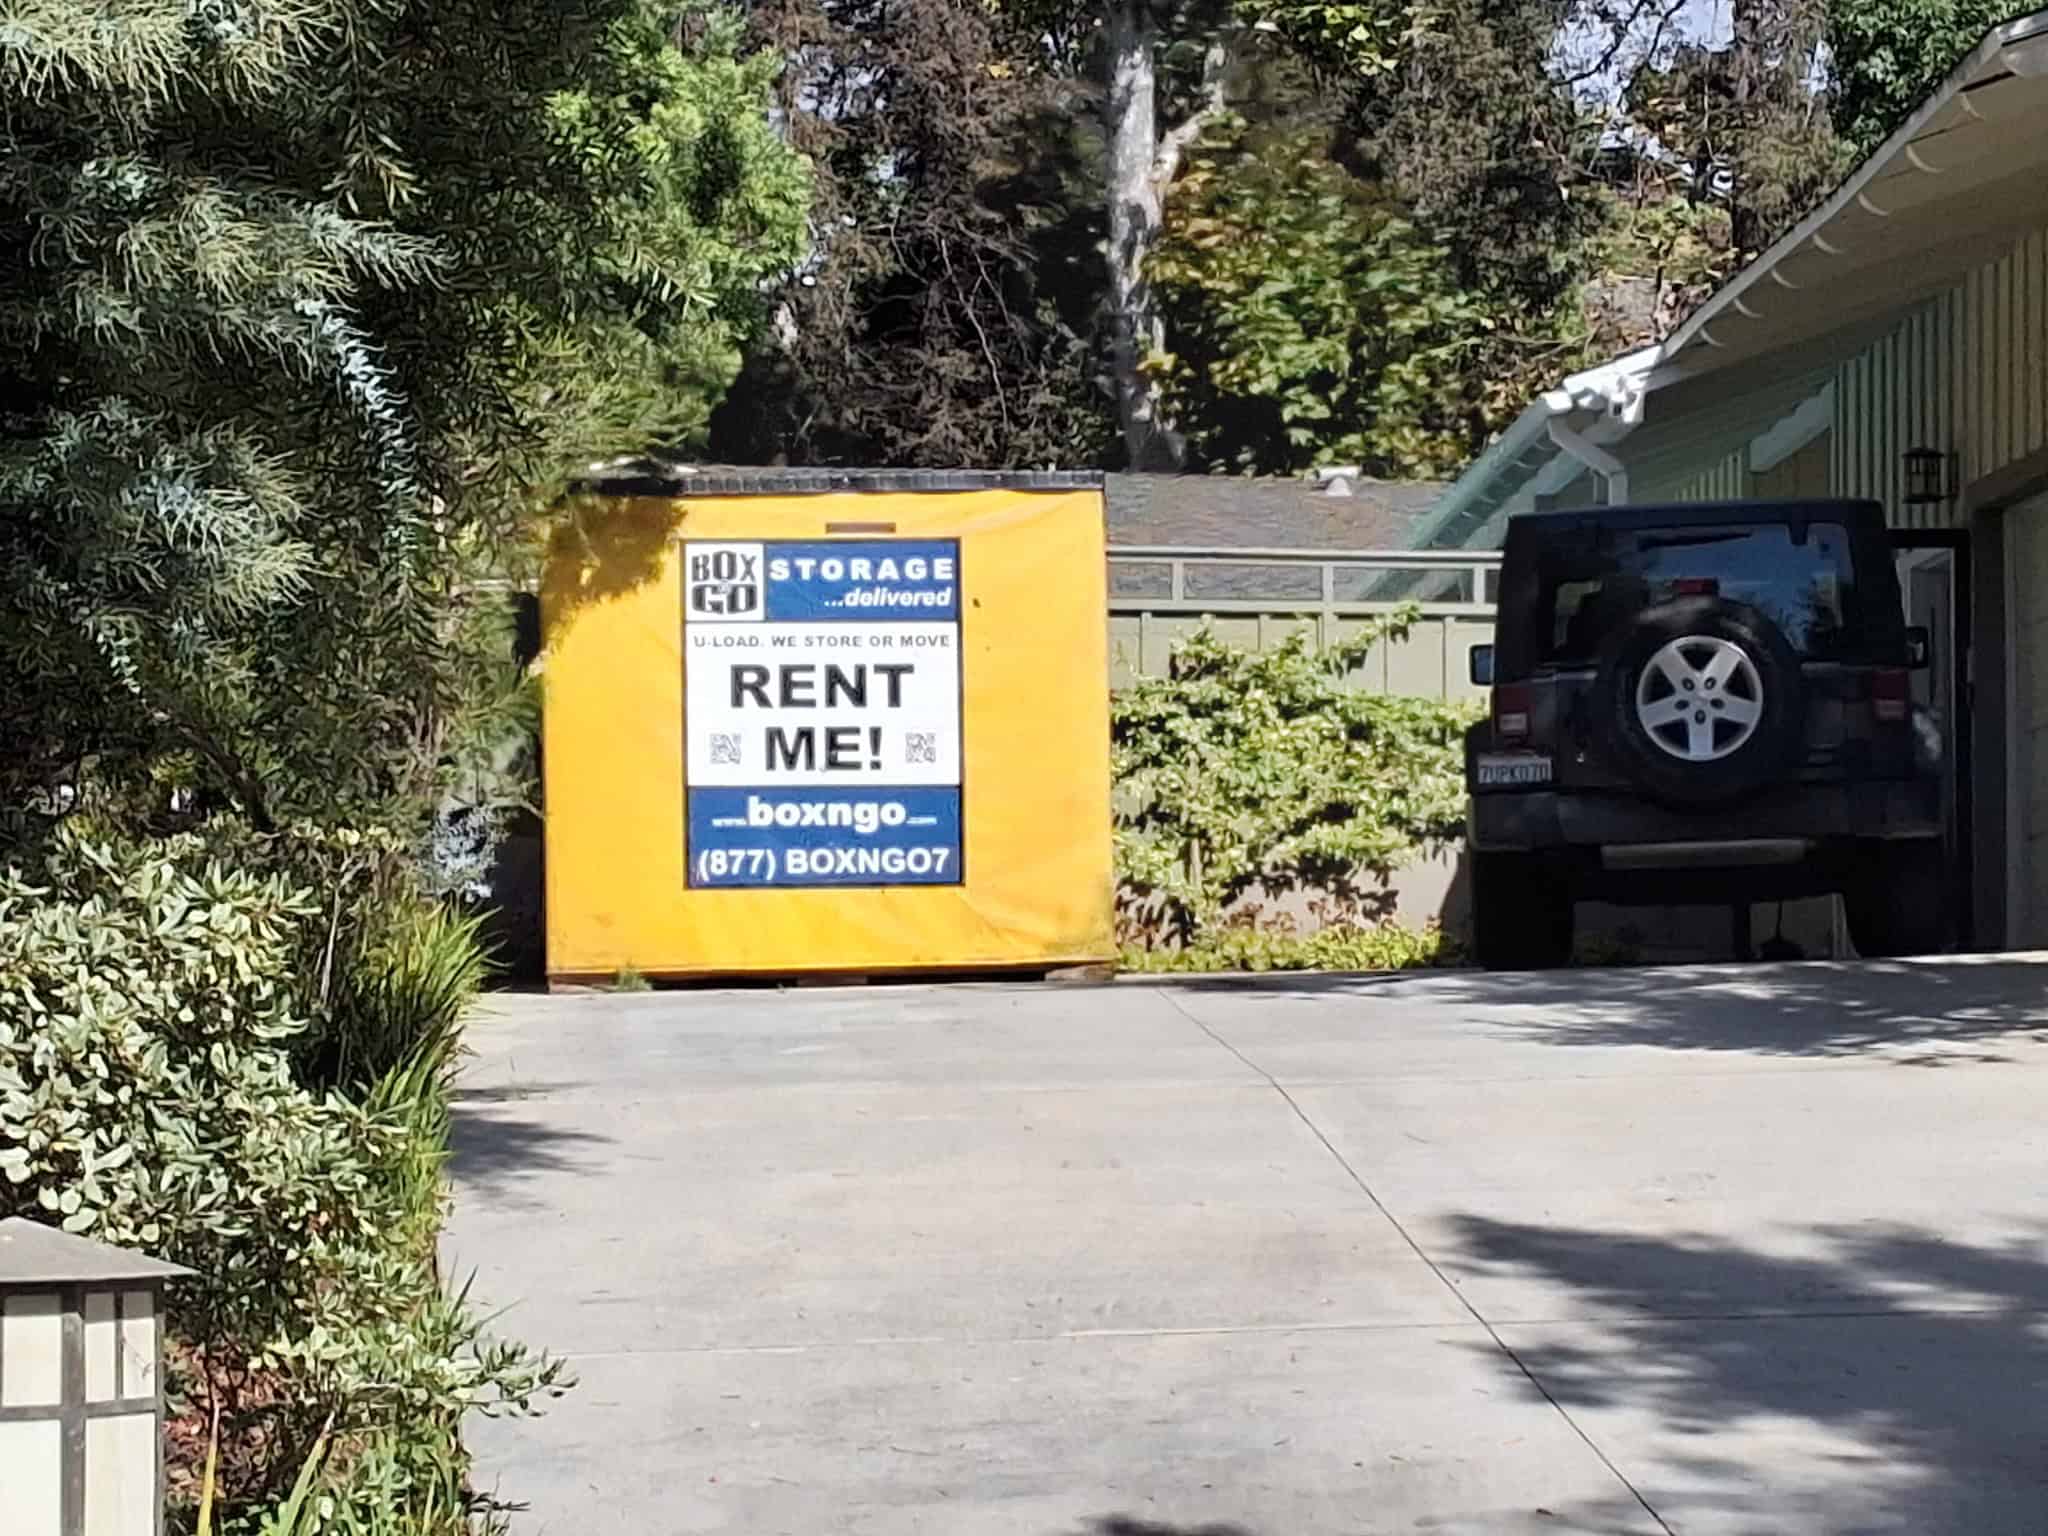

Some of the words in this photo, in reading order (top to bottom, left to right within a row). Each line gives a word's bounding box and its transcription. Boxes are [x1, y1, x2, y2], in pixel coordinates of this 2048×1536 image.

[692, 550, 757, 582] BOX
[769, 558, 954, 581] STORAGE
[692, 583, 758, 615] GO
[823, 587, 952, 607] ...delivered
[771, 635, 797, 648] WE
[804, 635, 863, 648] STORE
[870, 635, 893, 648] OR
[900, 635, 950, 648] MOVE
[730, 664, 915, 708] RENT
[765, 726, 883, 771] ME!
[699, 848, 777, 881] (877)
[786, 848, 949, 874] BOXNGO7
